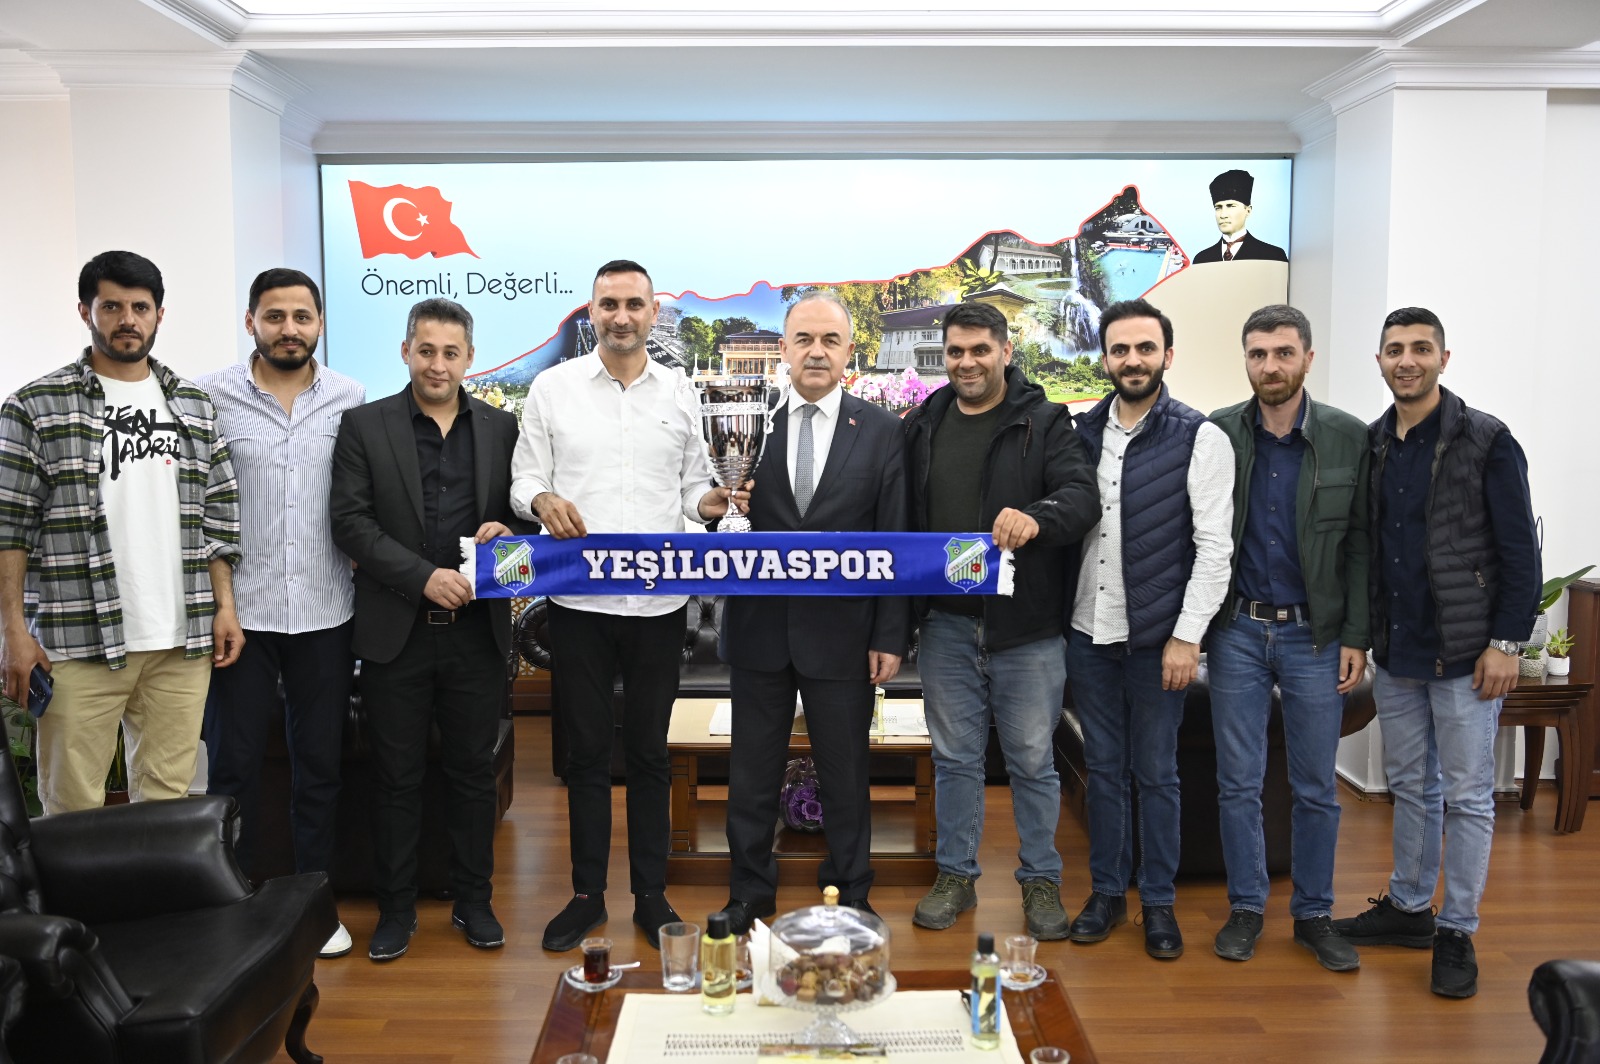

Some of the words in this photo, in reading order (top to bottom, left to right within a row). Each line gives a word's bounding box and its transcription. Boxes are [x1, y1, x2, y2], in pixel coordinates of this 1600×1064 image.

[361, 268, 458, 299] Önemli,
[466, 271, 573, 300] Değerli...
[582, 541, 895, 590] YEŞİLOVASPOR
